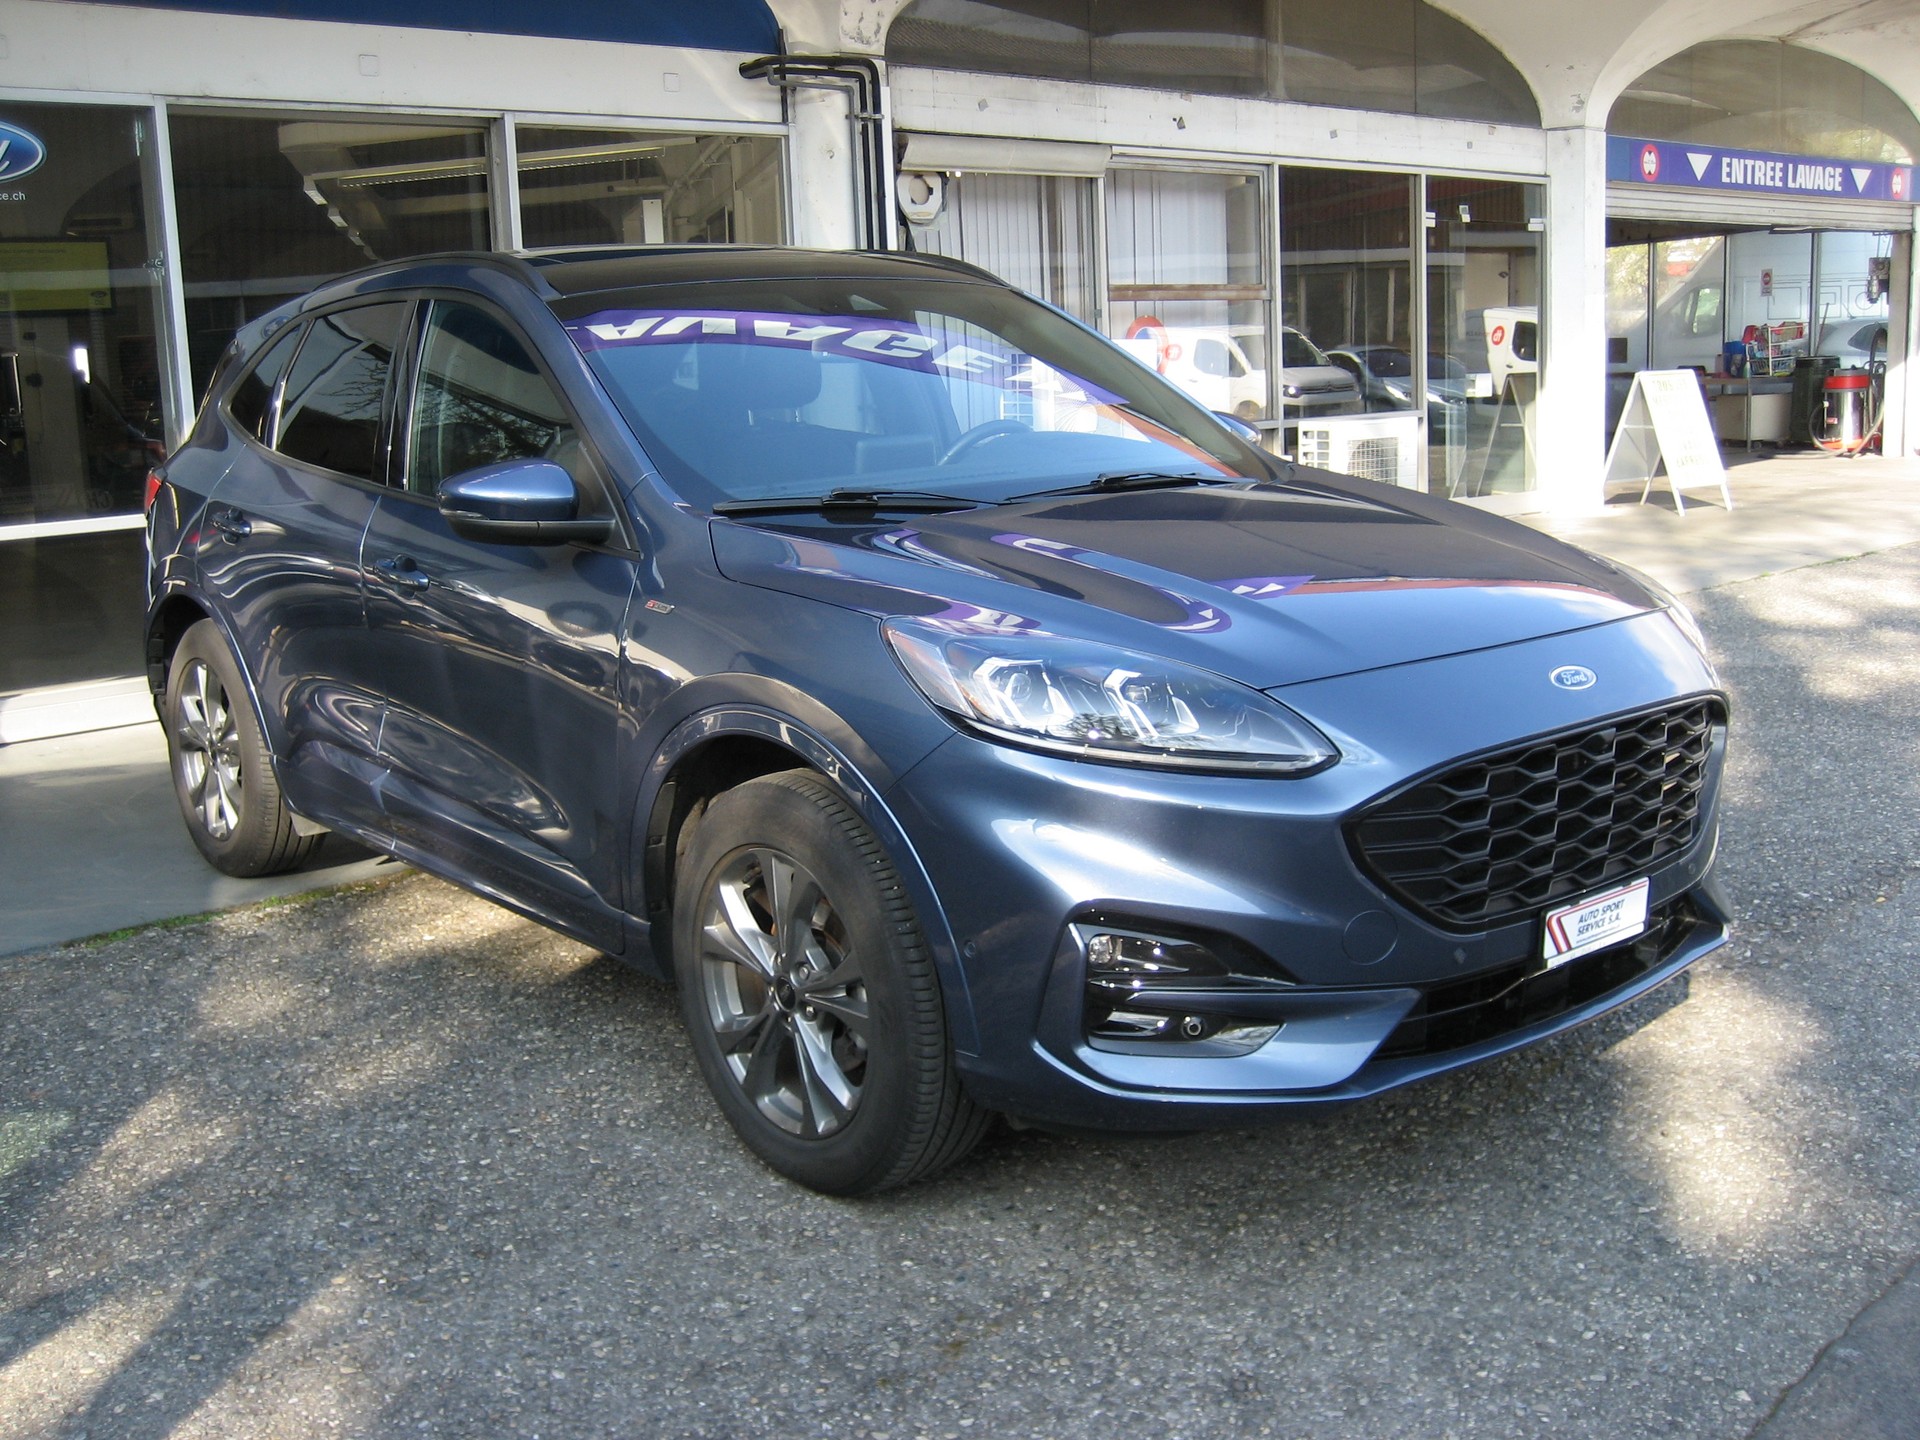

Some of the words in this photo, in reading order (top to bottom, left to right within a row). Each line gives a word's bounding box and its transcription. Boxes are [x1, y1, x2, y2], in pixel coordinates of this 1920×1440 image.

[1721, 157, 1783, 188] ENTREE
[1787, 163, 1843, 192] LAVAGE
[1561, 671, 1588, 685] Ford
[1578, 909, 1600, 923] AUTO
[1601, 899, 1625, 916] SPORT
[1576, 919, 1606, 936] SERVICE
